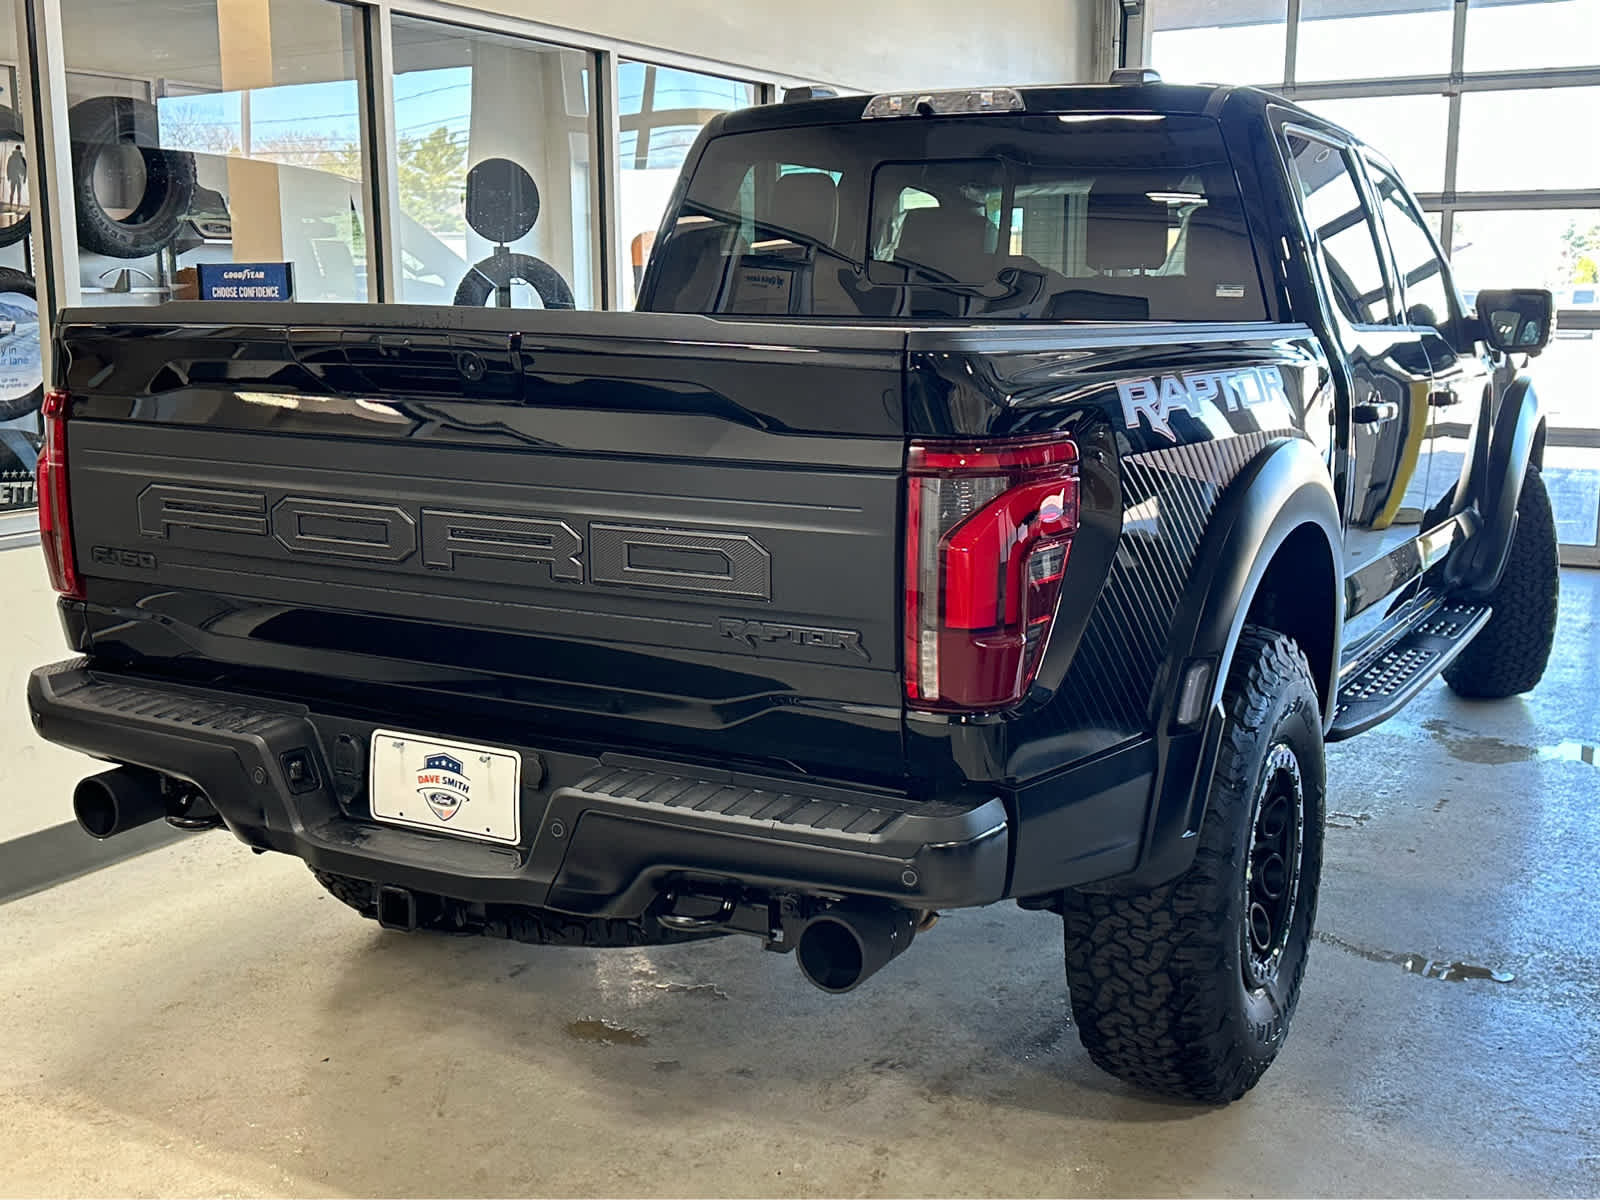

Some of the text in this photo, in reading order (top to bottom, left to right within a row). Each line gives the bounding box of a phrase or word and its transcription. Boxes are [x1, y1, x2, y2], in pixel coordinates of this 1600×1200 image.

[223, 269, 265, 280] GOODYEAR
[212, 286, 280, 298] CHOOSE CONFIDENCE
[1115, 365, 1296, 443] RAPTOR
[136, 482, 773, 603] FORD
[718, 616, 872, 663] RAPTOR
[417, 775, 470, 793] DAVE SMITH
